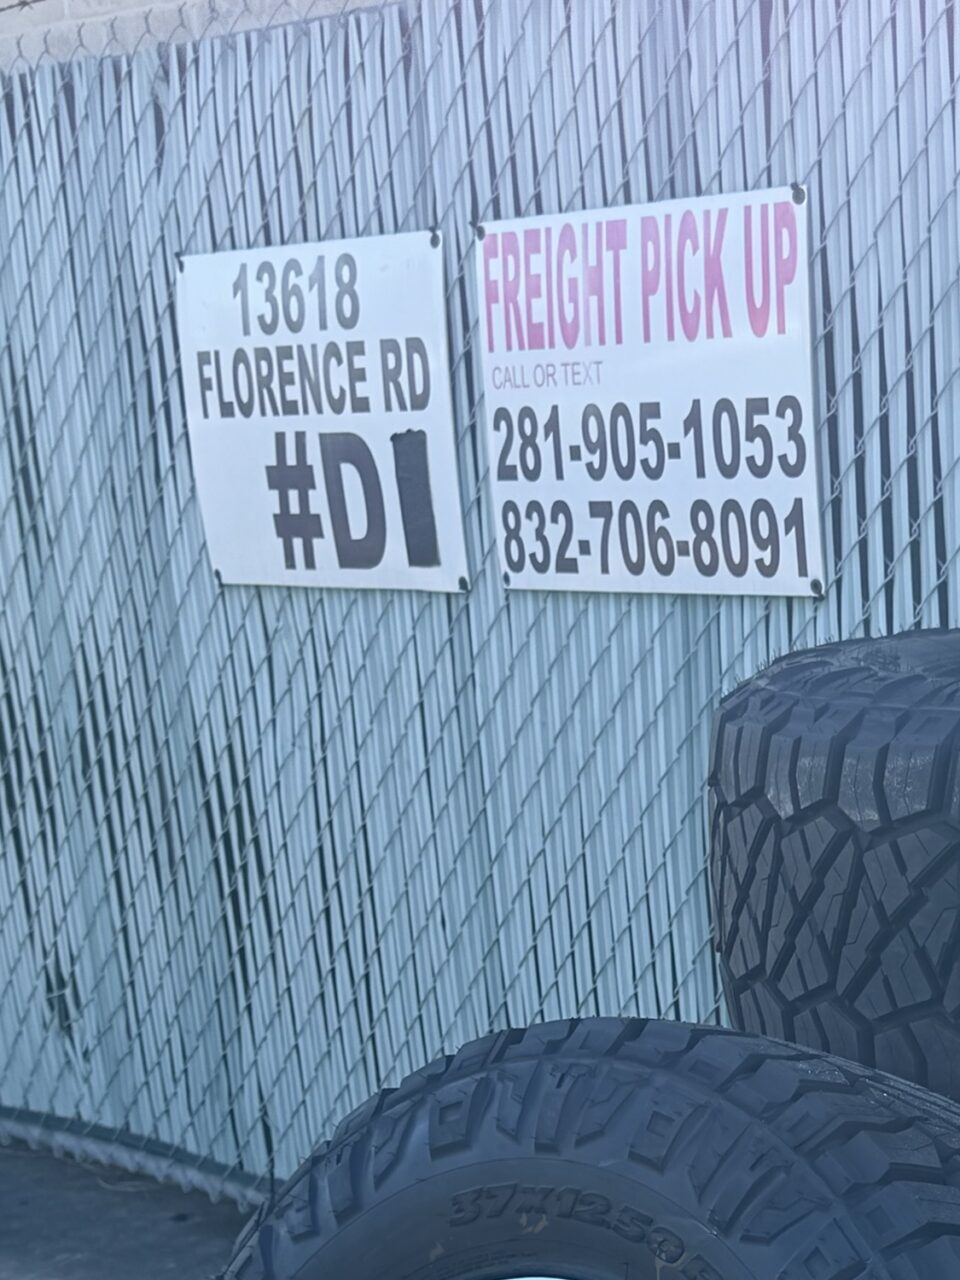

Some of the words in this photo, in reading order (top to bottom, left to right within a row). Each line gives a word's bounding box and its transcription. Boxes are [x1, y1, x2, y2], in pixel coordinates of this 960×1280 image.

[232, 252, 360, 336] 13618
[482, 219, 627, 354] FREIGHT
[640, 208, 731, 343] PICK
[743, 200, 798, 338] UP
[196, 341, 370, 419] FLORENCE
[382, 336, 431, 412] RD
[491, 363, 531, 390] CALL
[533, 363, 559, 388] OR
[561, 361, 604, 386] TEXT
[493, 395, 807, 482] 281-905-1053
[502, 497, 810, 579] 832-706-8091
